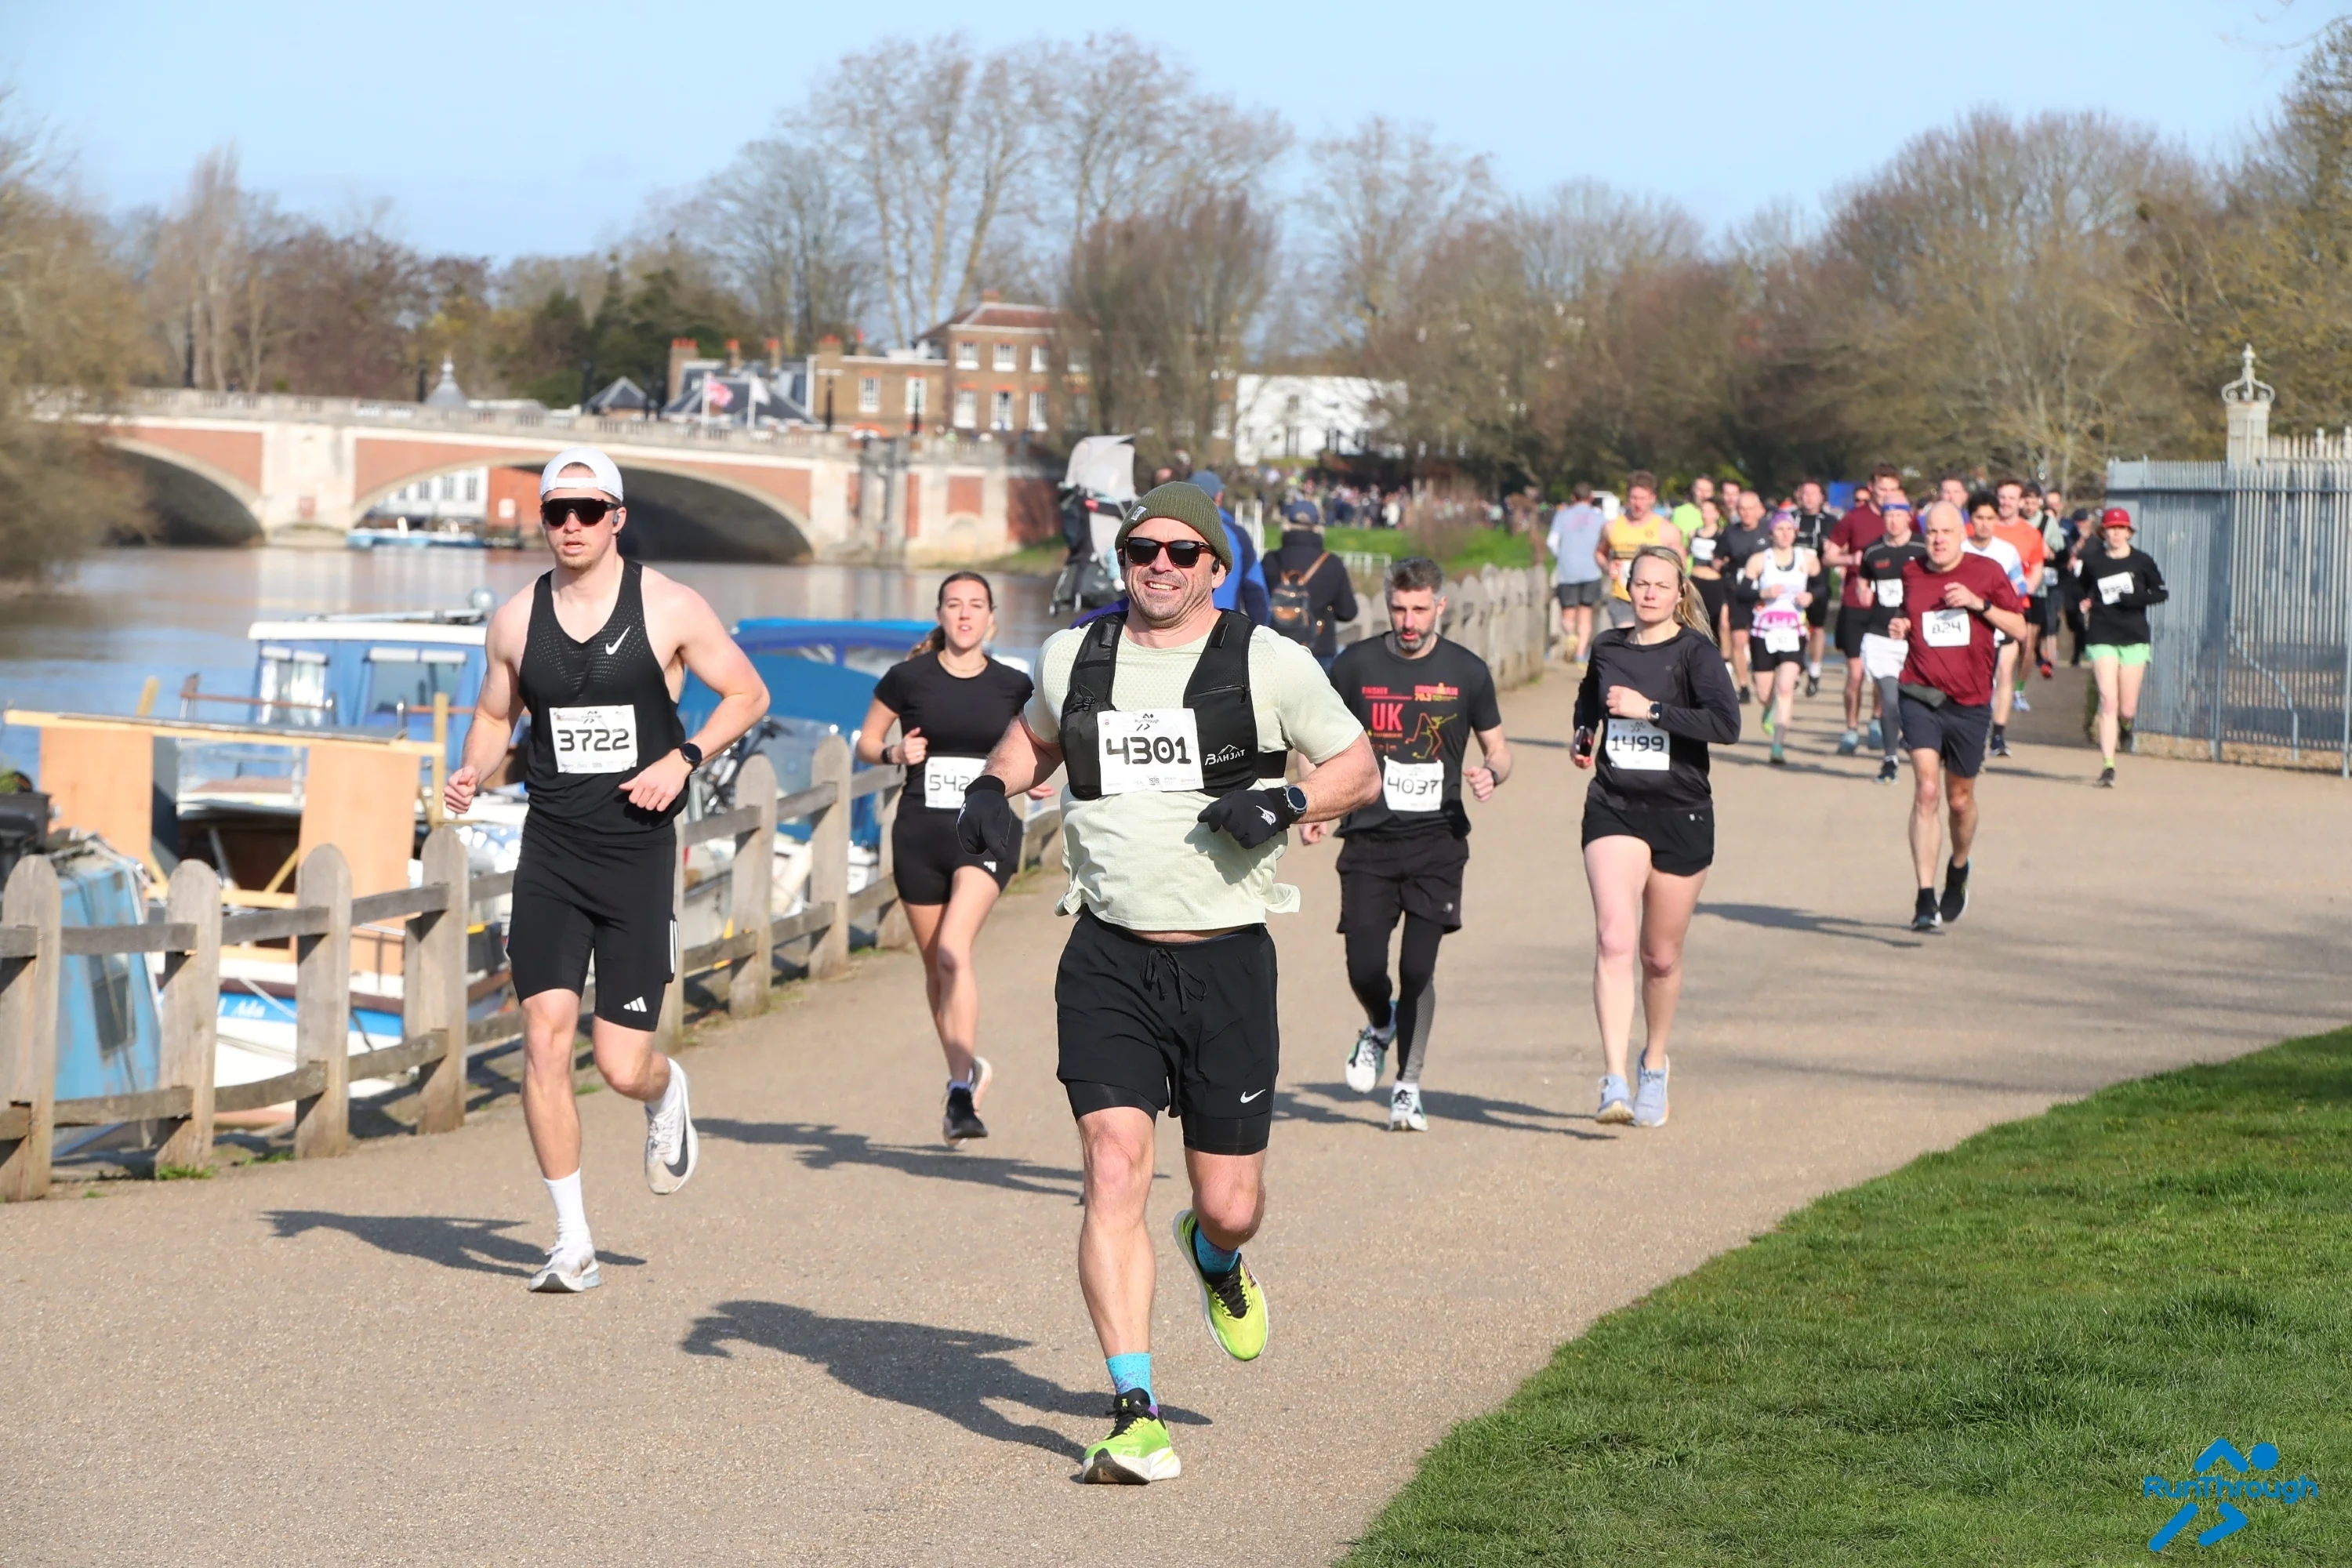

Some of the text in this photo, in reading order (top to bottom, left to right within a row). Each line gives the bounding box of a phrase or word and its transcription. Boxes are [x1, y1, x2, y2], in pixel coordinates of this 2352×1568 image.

[1372, 702, 1404, 731] UK
[557, 728, 630, 752] 3722
[1612, 734, 1664, 752] 1499
[1105, 736, 1192, 765] 4301
[1204, 749, 1246, 766] BAHJAT
[929, 774, 975, 792] 542
[1387, 776, 1439, 795] 4037
